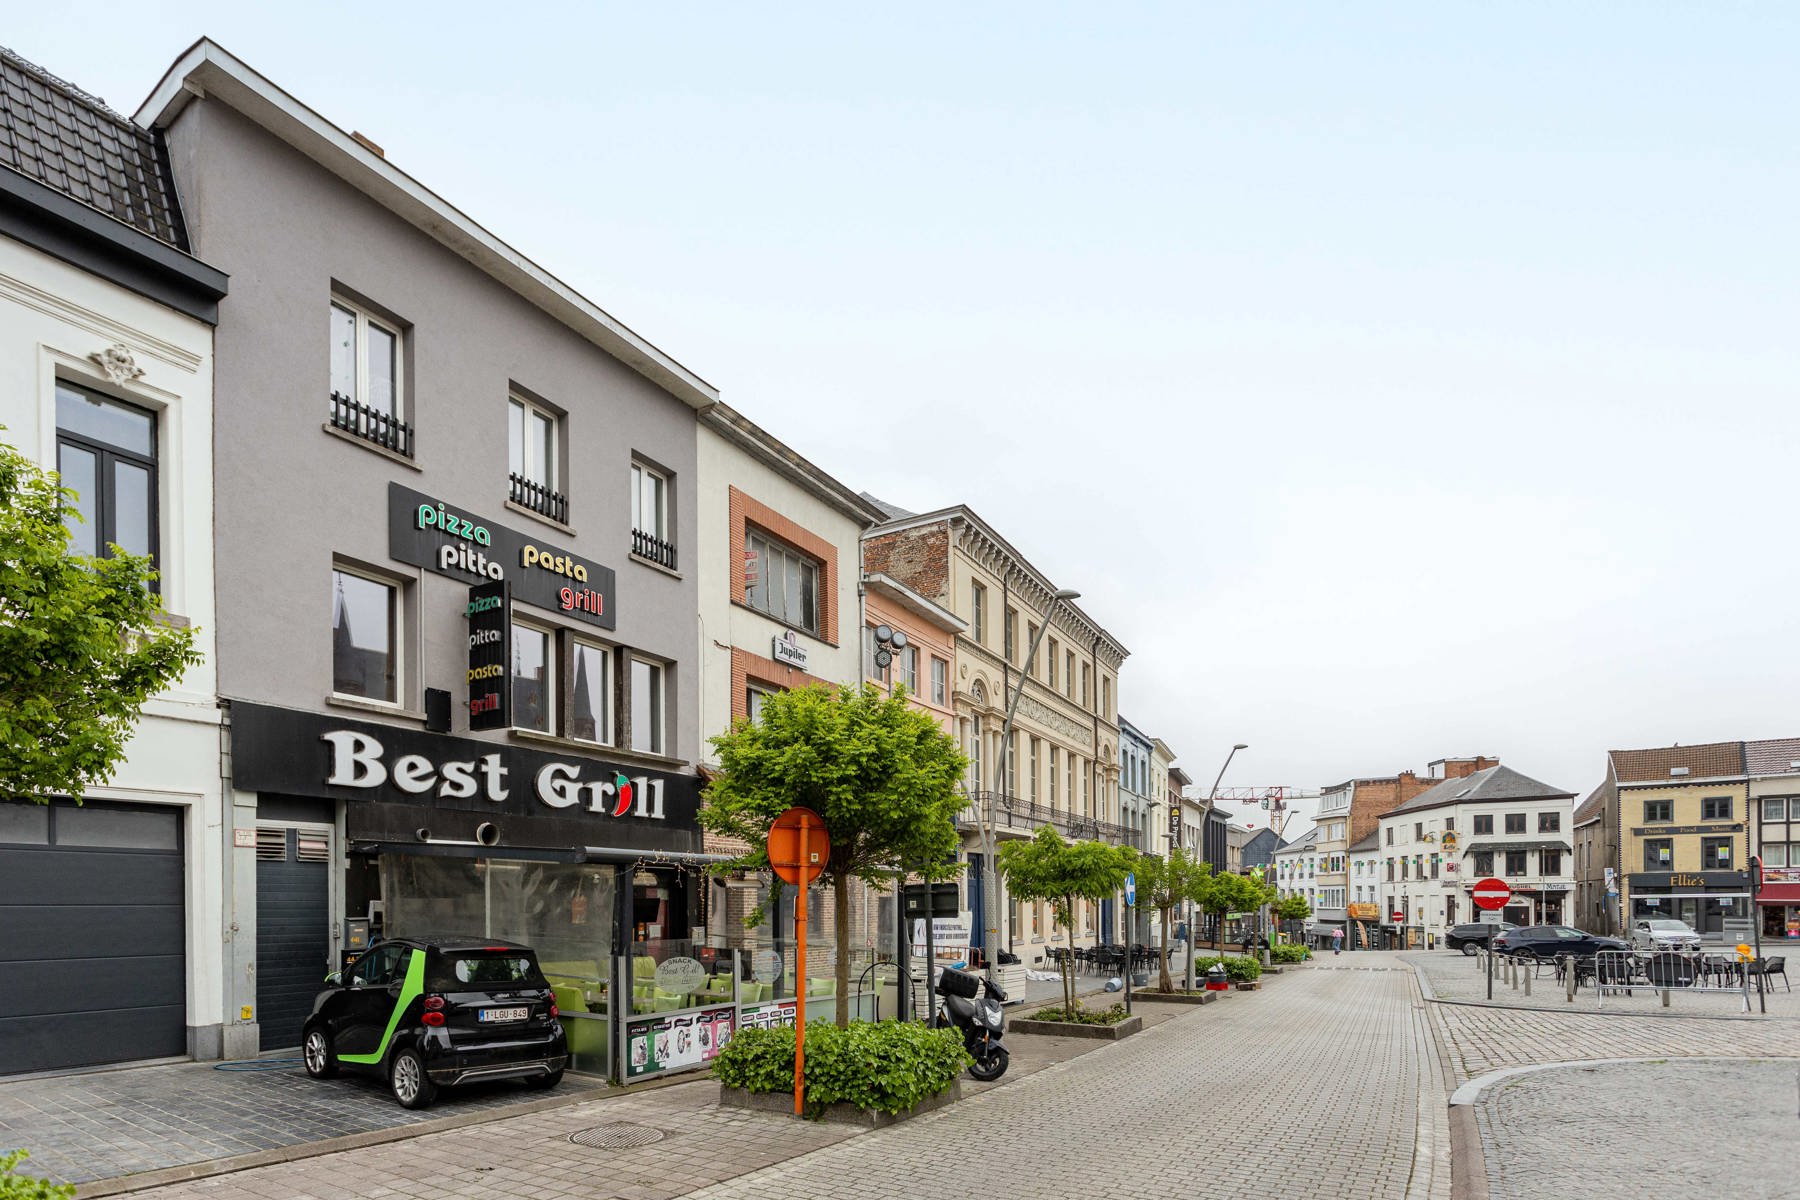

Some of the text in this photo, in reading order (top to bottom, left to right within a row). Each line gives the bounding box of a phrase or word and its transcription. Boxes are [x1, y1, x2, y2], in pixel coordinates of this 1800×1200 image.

[417, 503, 491, 546] pizza
[440, 543, 504, 580] pitta
[522, 545, 588, 583] pasta
[467, 595, 502, 617] pizza
[560, 587, 603, 616] grill
[469, 629, 501, 650] pitta
[778, 642, 807, 663] Jupiler
[466, 664, 503, 684] pasta
[470, 693, 500, 715] grill
[321, 729, 666, 820] Best Grill
[1670, 874, 1705, 887] Ellie's
[667, 957, 693, 966] SNACK
[486, 1008, 528, 1020] 1-LGU-849
